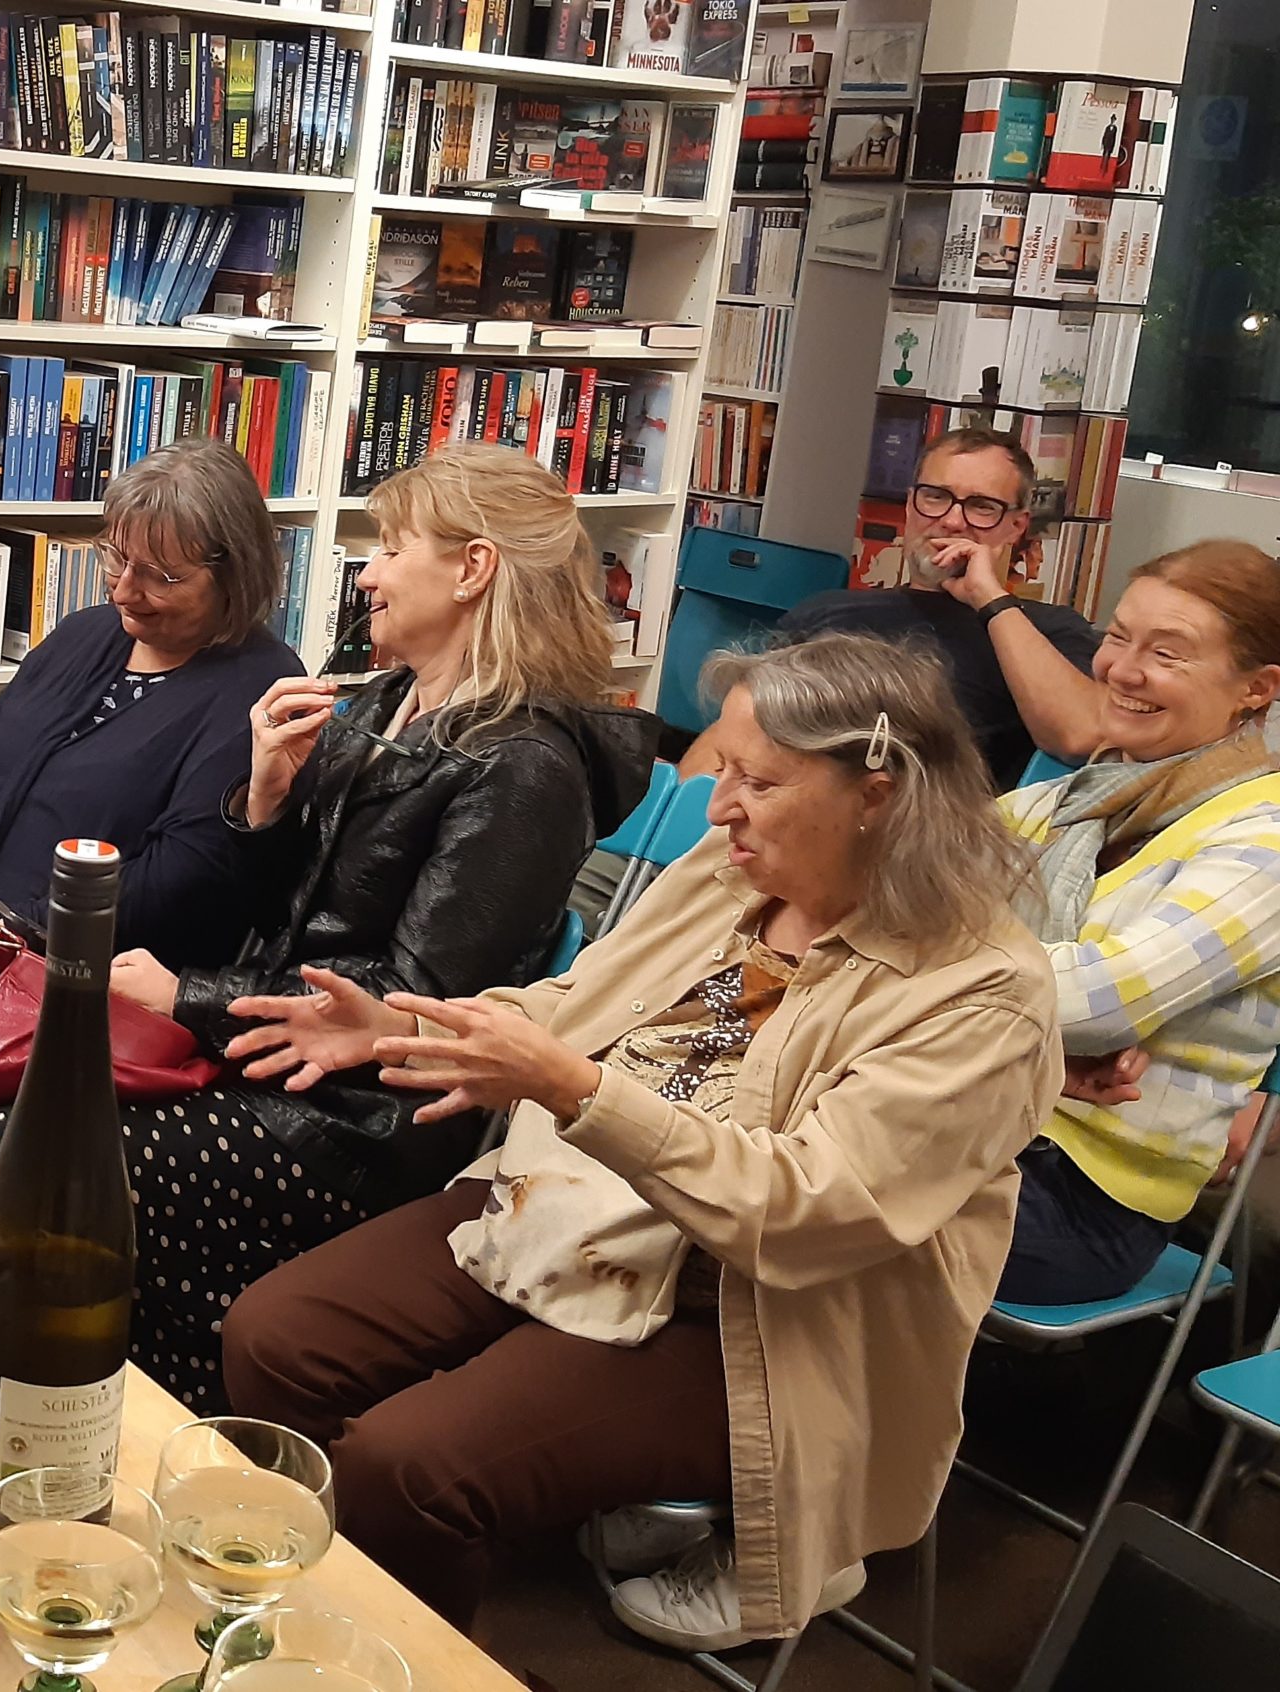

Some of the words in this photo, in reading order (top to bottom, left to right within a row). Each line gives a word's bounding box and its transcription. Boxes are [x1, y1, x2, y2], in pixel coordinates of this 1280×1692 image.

[626, 52, 681, 73] MINNESOTA
[493, 129, 510, 171] LINK
[1030, 225, 1043, 259] MANN
[1047, 236, 1058, 265] MANN
[1117, 231, 1128, 265] MANN
[1137, 232, 1150, 267] MANN
[367, 367, 380, 395] DAVID
[477, 378, 488, 421] FESTUNG
[183, 413, 191, 438] STILLE
[363, 396, 377, 438] BALDACCI
[398, 394, 411, 440] GRISHAM
[474, 423, 483, 440] DIE
[375, 421, 388, 471] PRESTON
[395, 441, 405, 469] JOHN
[611, 429, 622, 452] HOLT
[608, 454, 619, 480] ANNE
[329, 574, 340, 602] Horror
[327, 609, 337, 638] FITZEK
